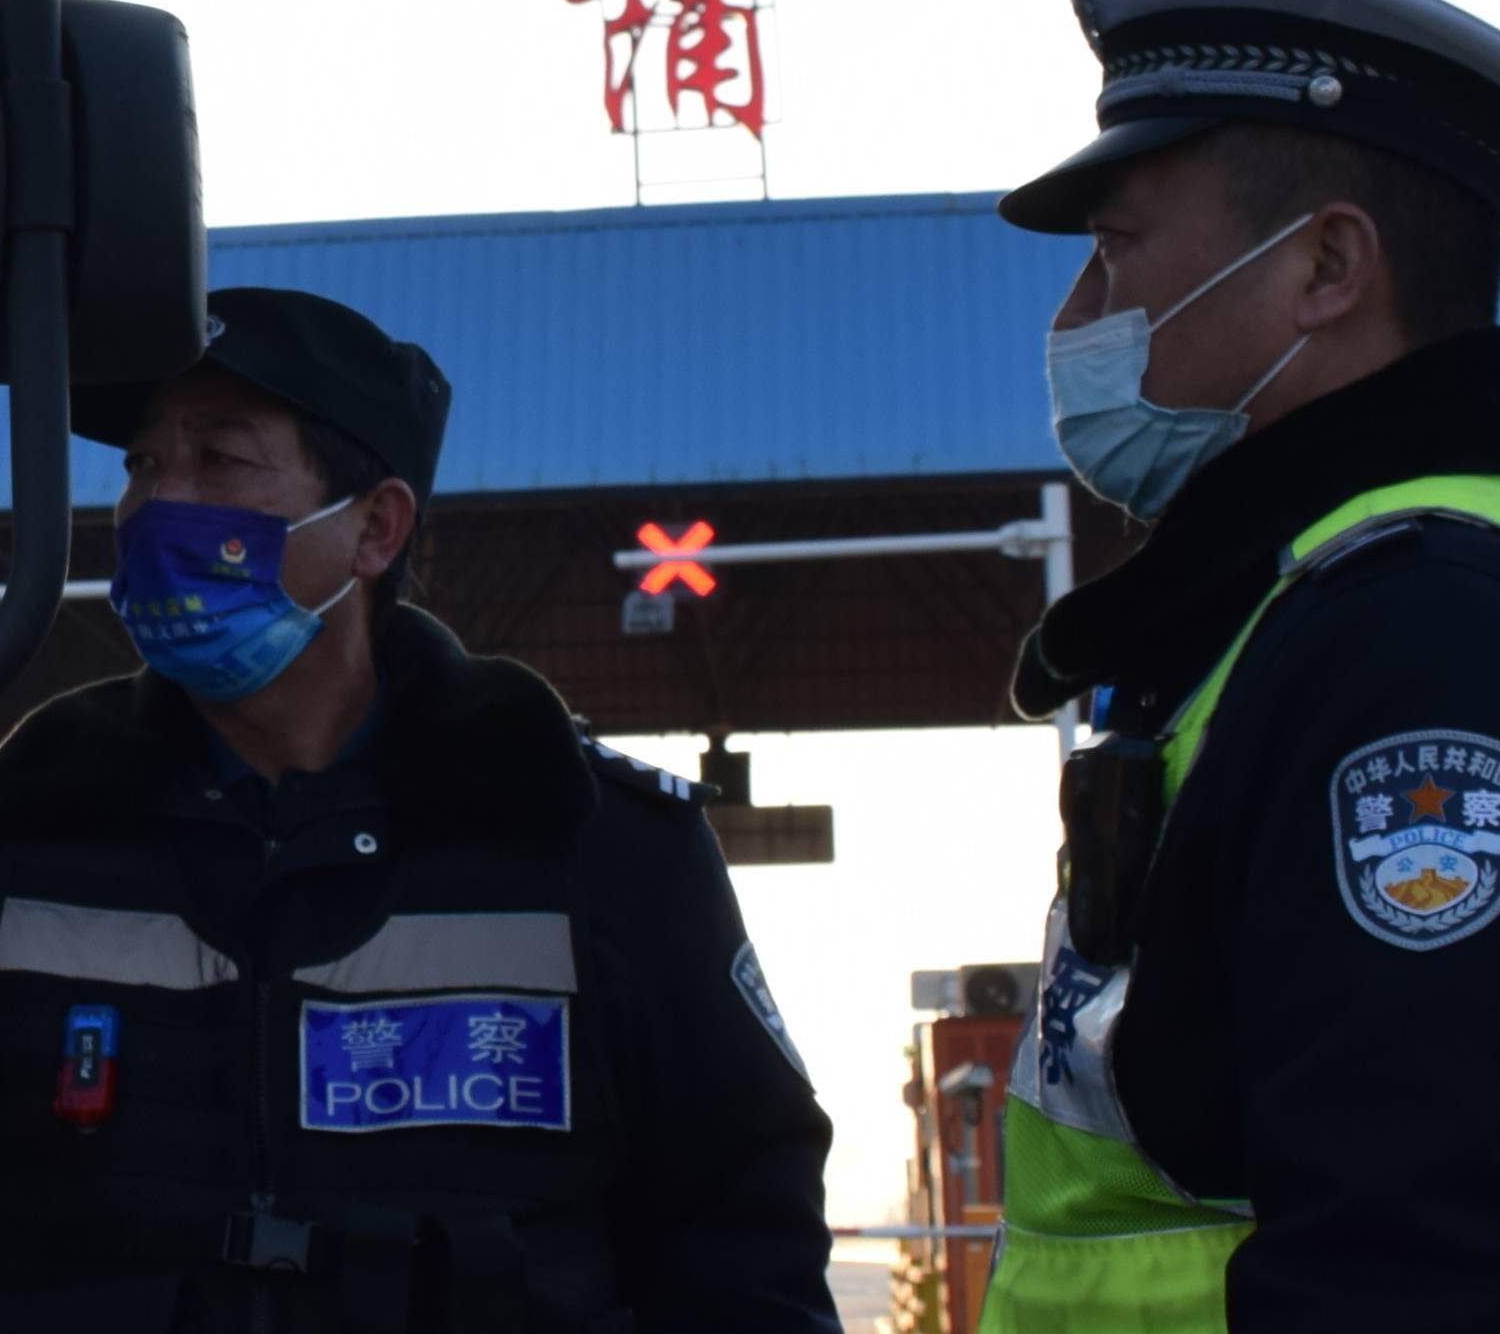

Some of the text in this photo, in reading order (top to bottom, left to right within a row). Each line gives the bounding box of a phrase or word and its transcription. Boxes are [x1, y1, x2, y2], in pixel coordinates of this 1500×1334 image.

[1389, 829, 1467, 851] POLICE
[341, 1011, 528, 1072] 警察
[325, 1073, 544, 1116] POLICE
